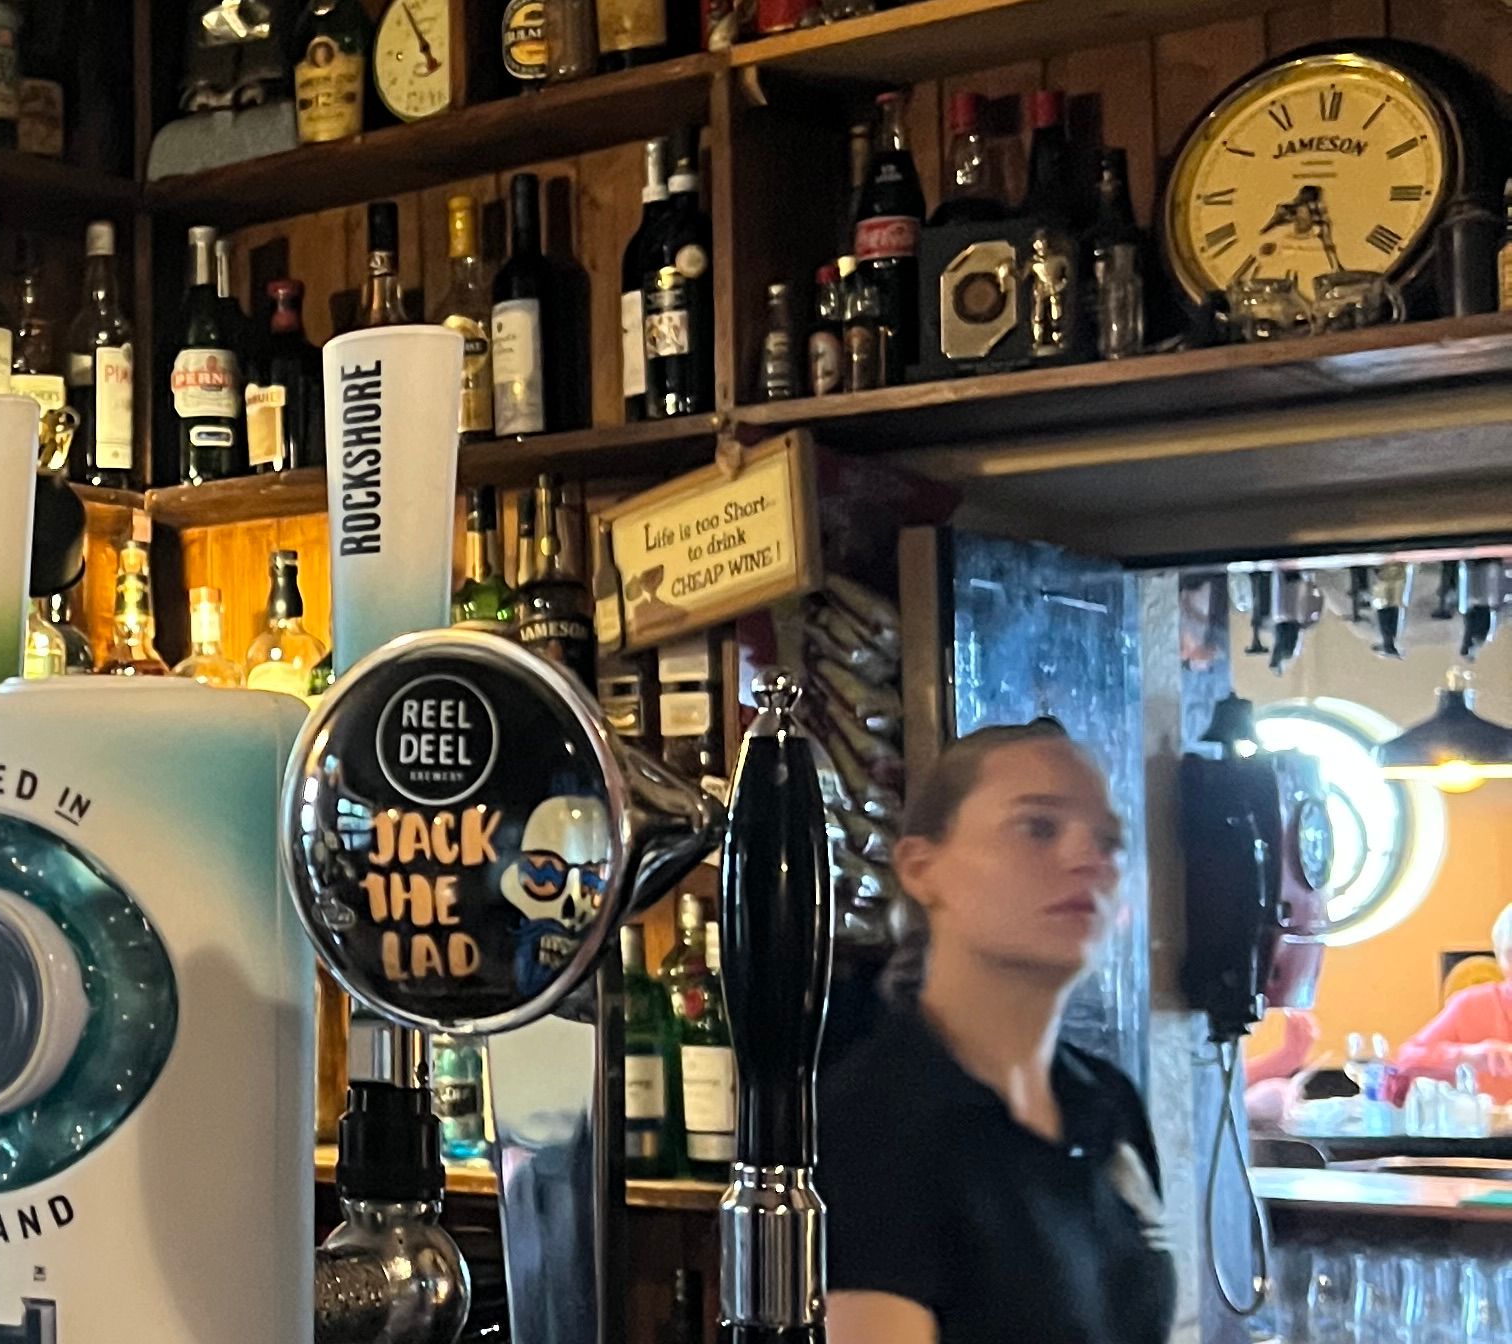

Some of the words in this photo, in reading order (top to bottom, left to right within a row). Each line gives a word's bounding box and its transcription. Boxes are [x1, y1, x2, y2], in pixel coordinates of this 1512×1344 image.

[1273, 135, 1368, 159] JAMESON
[339, 359, 382, 556] ROCKSHORE
[644, 522, 675, 552] Life
[679, 523, 691, 541] is
[696, 514, 720, 535] too
[688, 545, 703, 562] to
[708, 527, 746, 556] drink
[670, 562, 724, 598] CHEAP
[728, 547, 774, 577] WINE
[401, 699, 473, 730] REEL
[399, 733, 473, 766] DEEL
[410, 771, 465, 782] BREWERY
[57, 786, 92, 824] IN
[368, 807, 503, 867] JACK
[359, 872, 461, 926] THE
[382, 931, 482, 981] LAD
